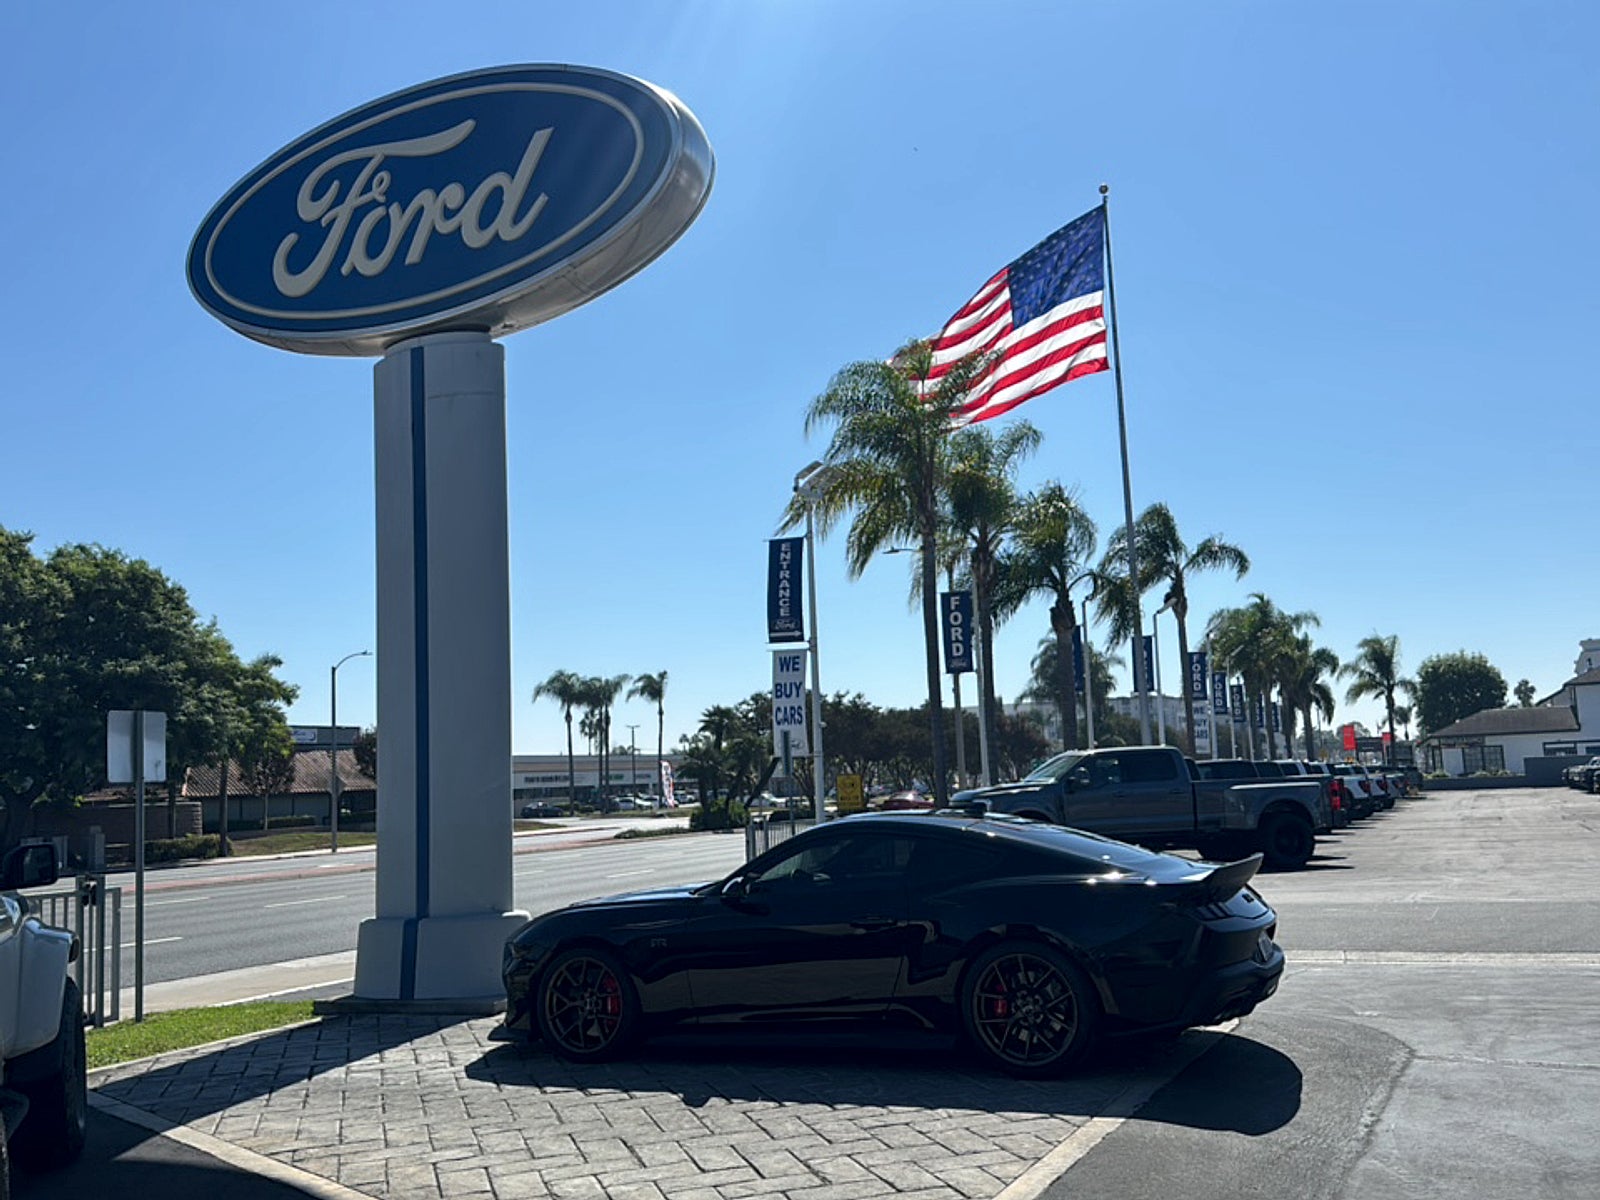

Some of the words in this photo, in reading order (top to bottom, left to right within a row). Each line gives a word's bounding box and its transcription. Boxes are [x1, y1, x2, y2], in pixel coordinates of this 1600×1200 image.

[272, 118, 555, 298] Ford
[778, 541, 792, 617] ENTRANCE
[949, 595, 965, 657] FORD
[778, 655, 801, 673] WE
[1192, 654, 1201, 691] FORD
[774, 682, 803, 700] BUY
[774, 706, 803, 726] CARS
